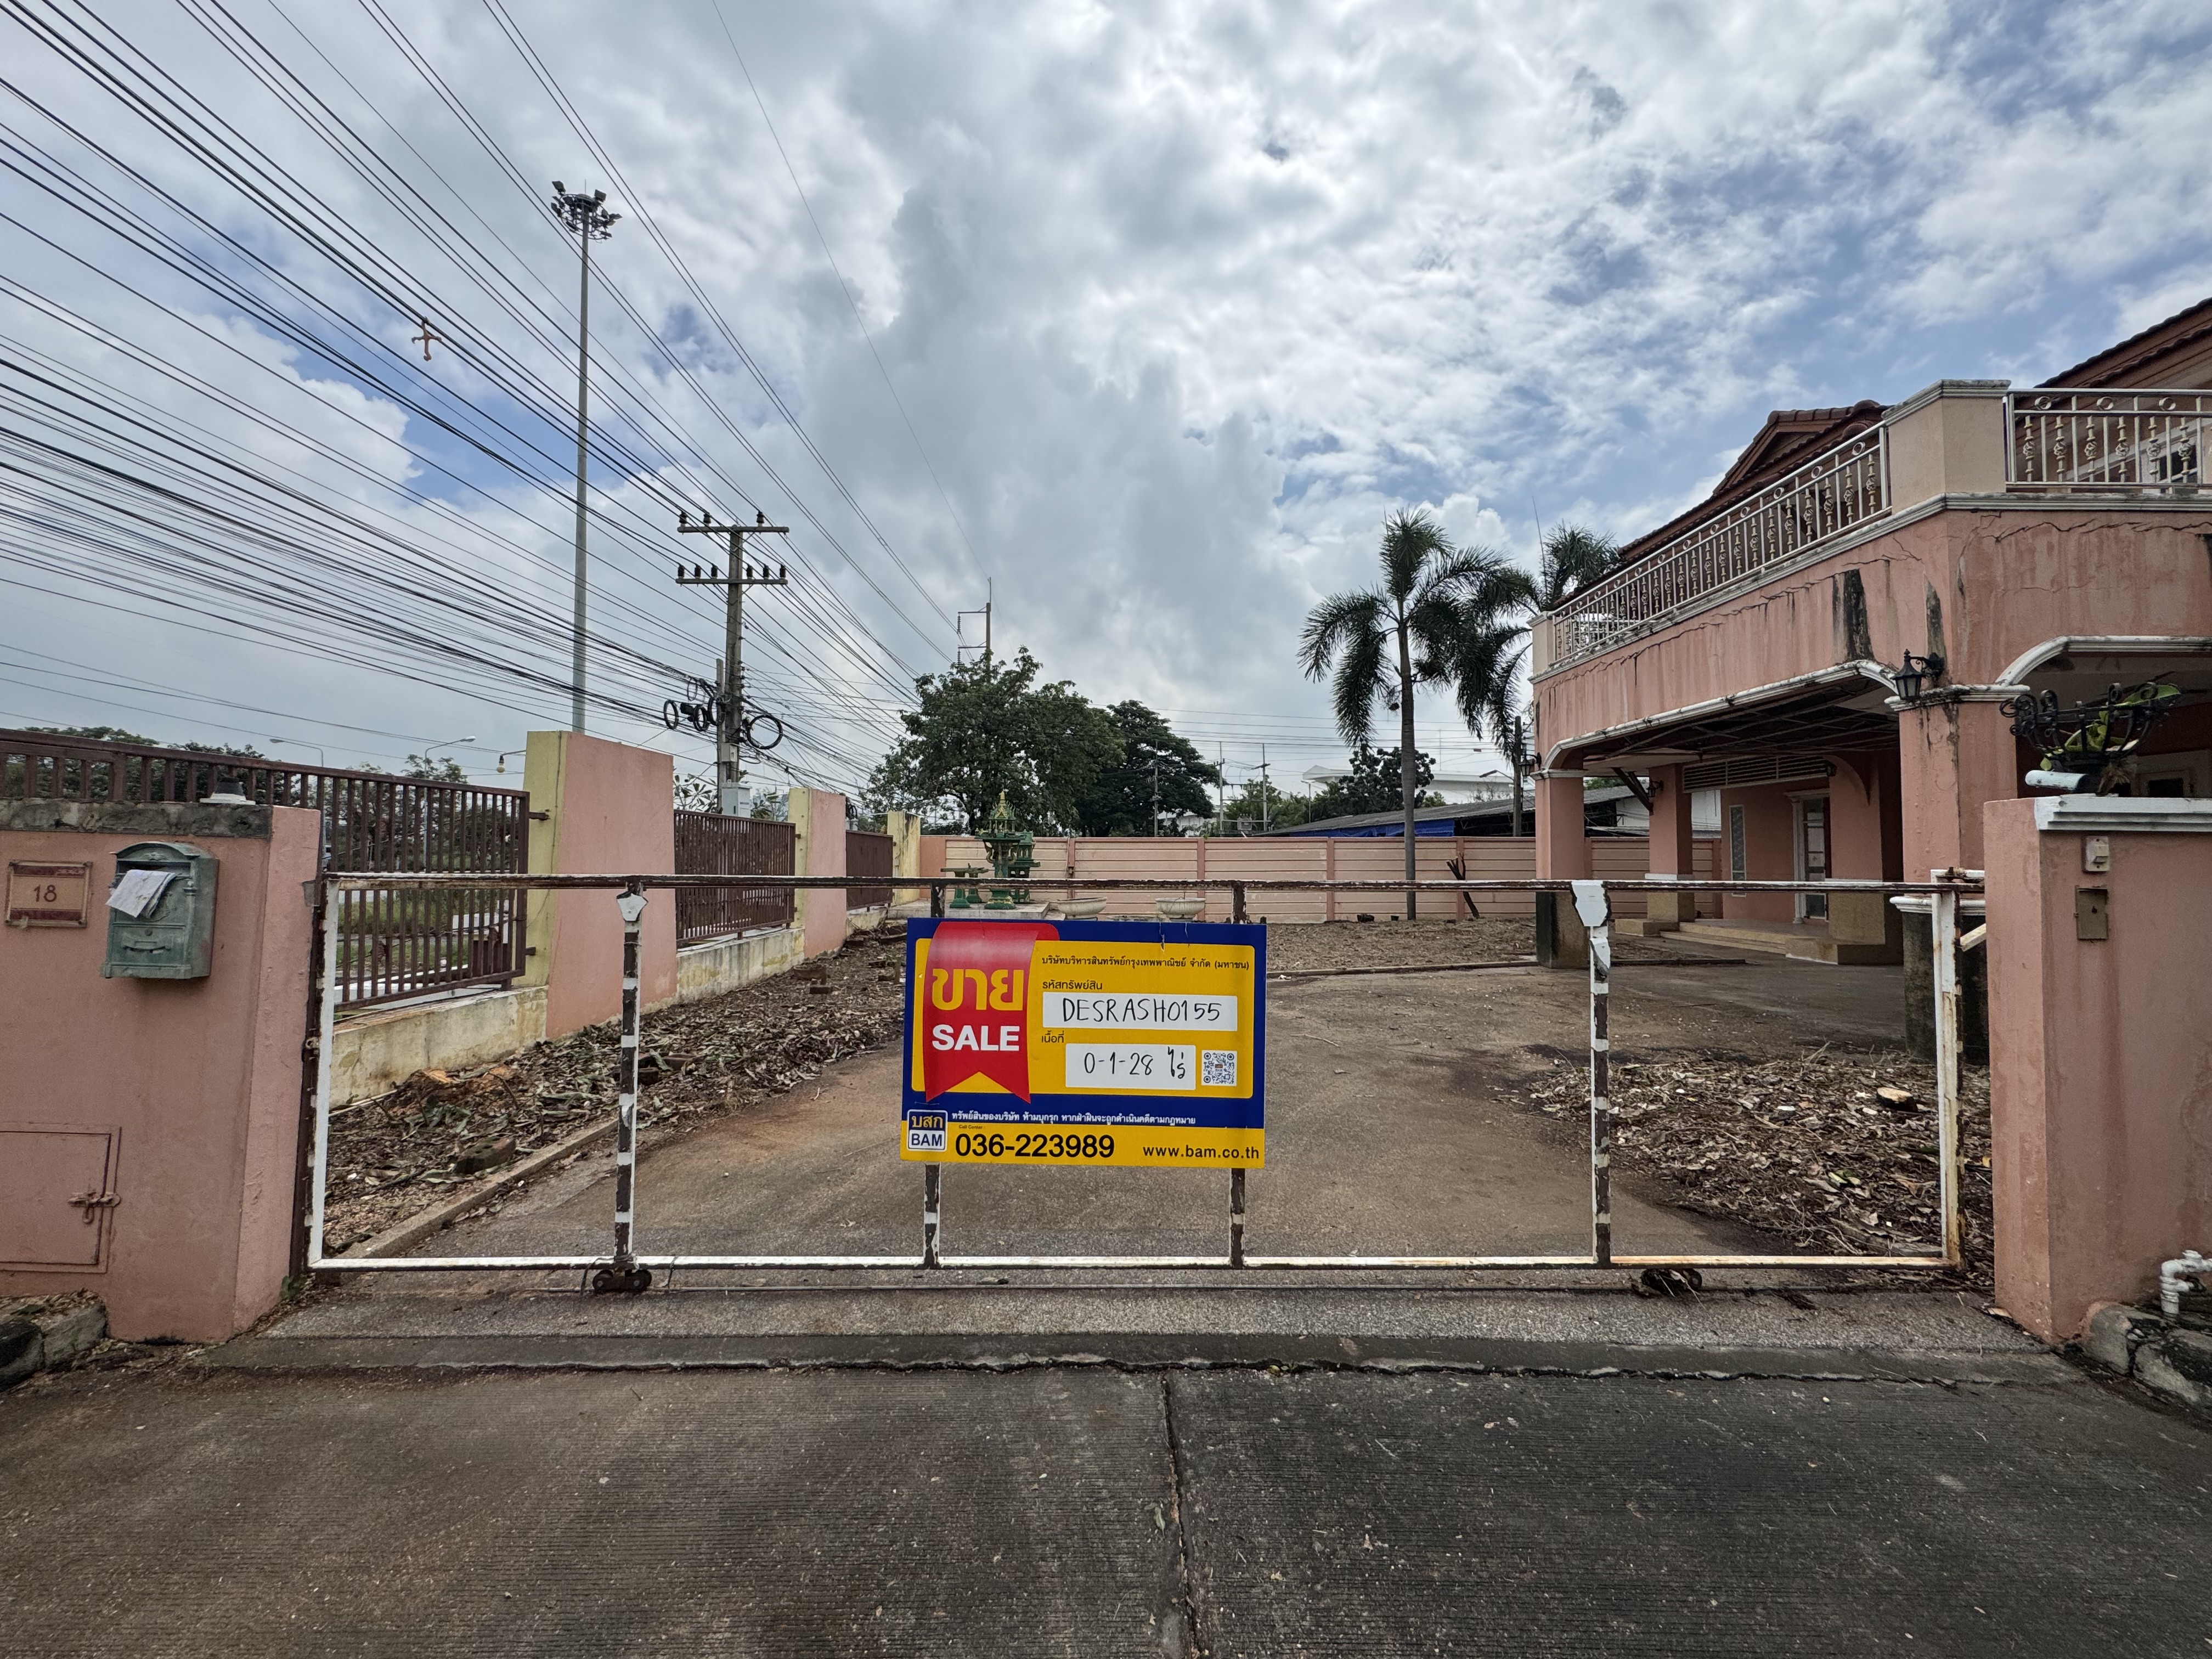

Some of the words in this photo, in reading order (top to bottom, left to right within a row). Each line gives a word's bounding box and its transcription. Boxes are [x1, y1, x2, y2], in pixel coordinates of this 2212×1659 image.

[33, 884, 57, 902] 18
[1042, 955, 1186, 969] บริษัทบริหารสินทรัพย์กรุงเทพพาณิชย์
[1189, 957, 1211, 968] จำกัด
[1214, 960, 1250, 970] (มหาชน)
[932, 967, 1024, 1012] ขาย
[1042, 979, 1103, 991] รหัสทรัพย์สิน
[932, 1024, 1020, 1052] SALE
[1041, 1030, 1064, 1043] เนื้อที่
[911, 1115, 943, 1129] บสก
[952, 1110, 1020, 1121] ทรัพย์สินของบริษัท
[1022, 1111, 1058, 1124] ห้ามบุกรุก
[911, 1133, 943, 1147] BAM
[955, 1133, 1114, 1158] 036-223989
[1143, 1144, 1259, 1159] www.bam.co.th
